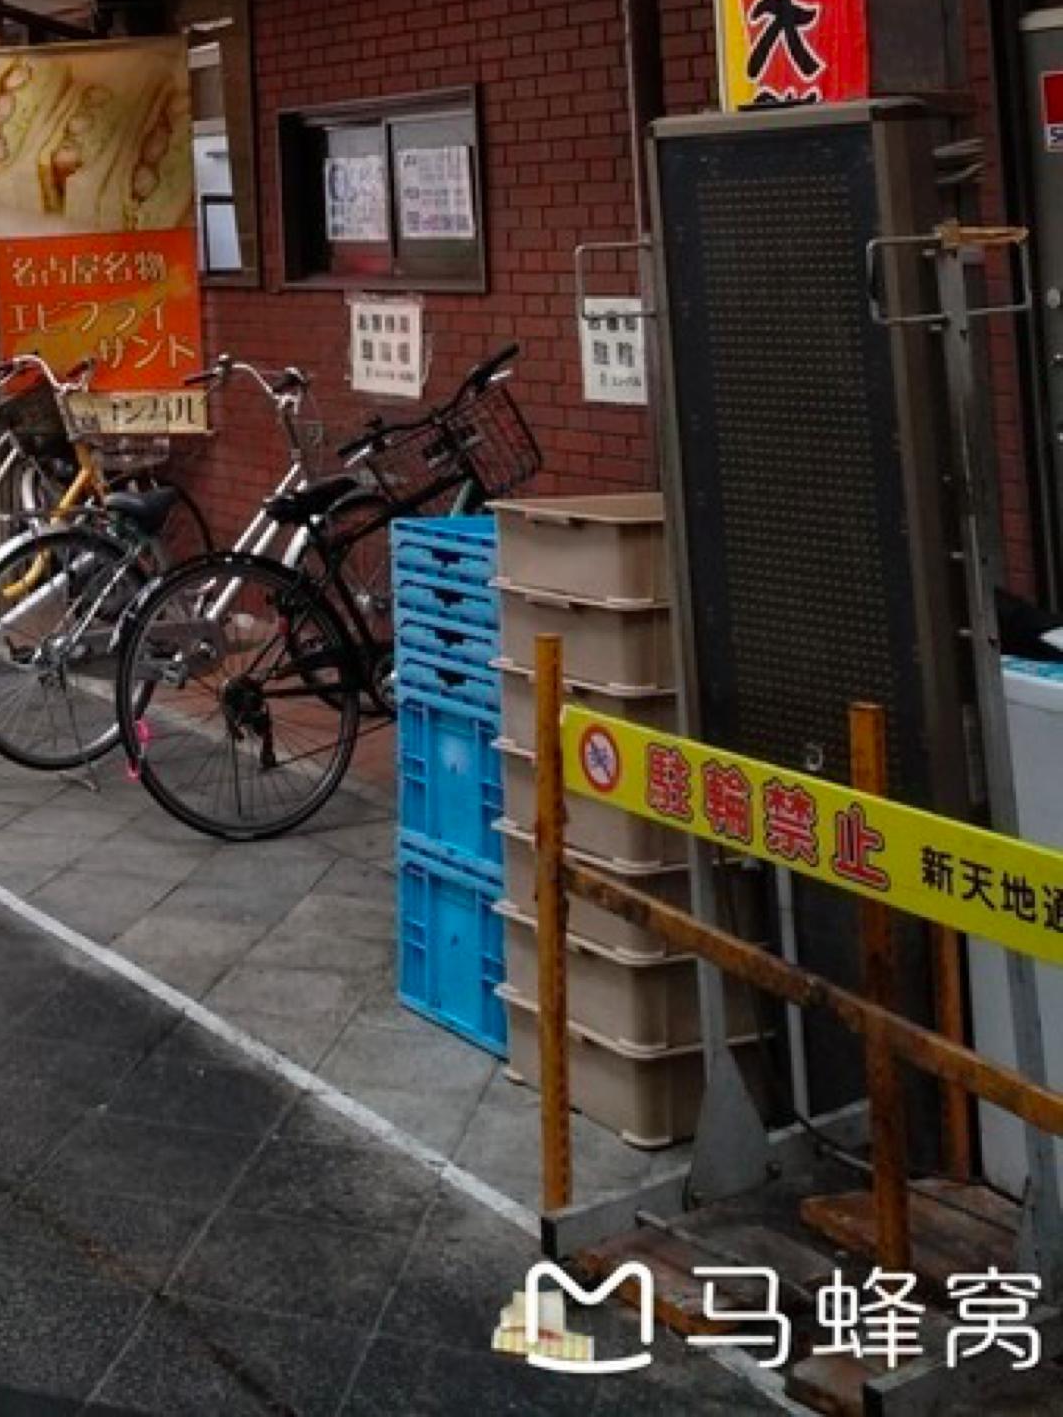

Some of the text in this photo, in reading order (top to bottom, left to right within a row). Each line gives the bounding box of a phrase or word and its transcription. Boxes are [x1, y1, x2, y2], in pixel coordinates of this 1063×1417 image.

[12, 250, 167, 287] 名古屋名物
[10, 298, 165, 333] エビフライ
[100, 335, 195, 369] サンド
[646, 742, 889, 892] 駐輪禁止
